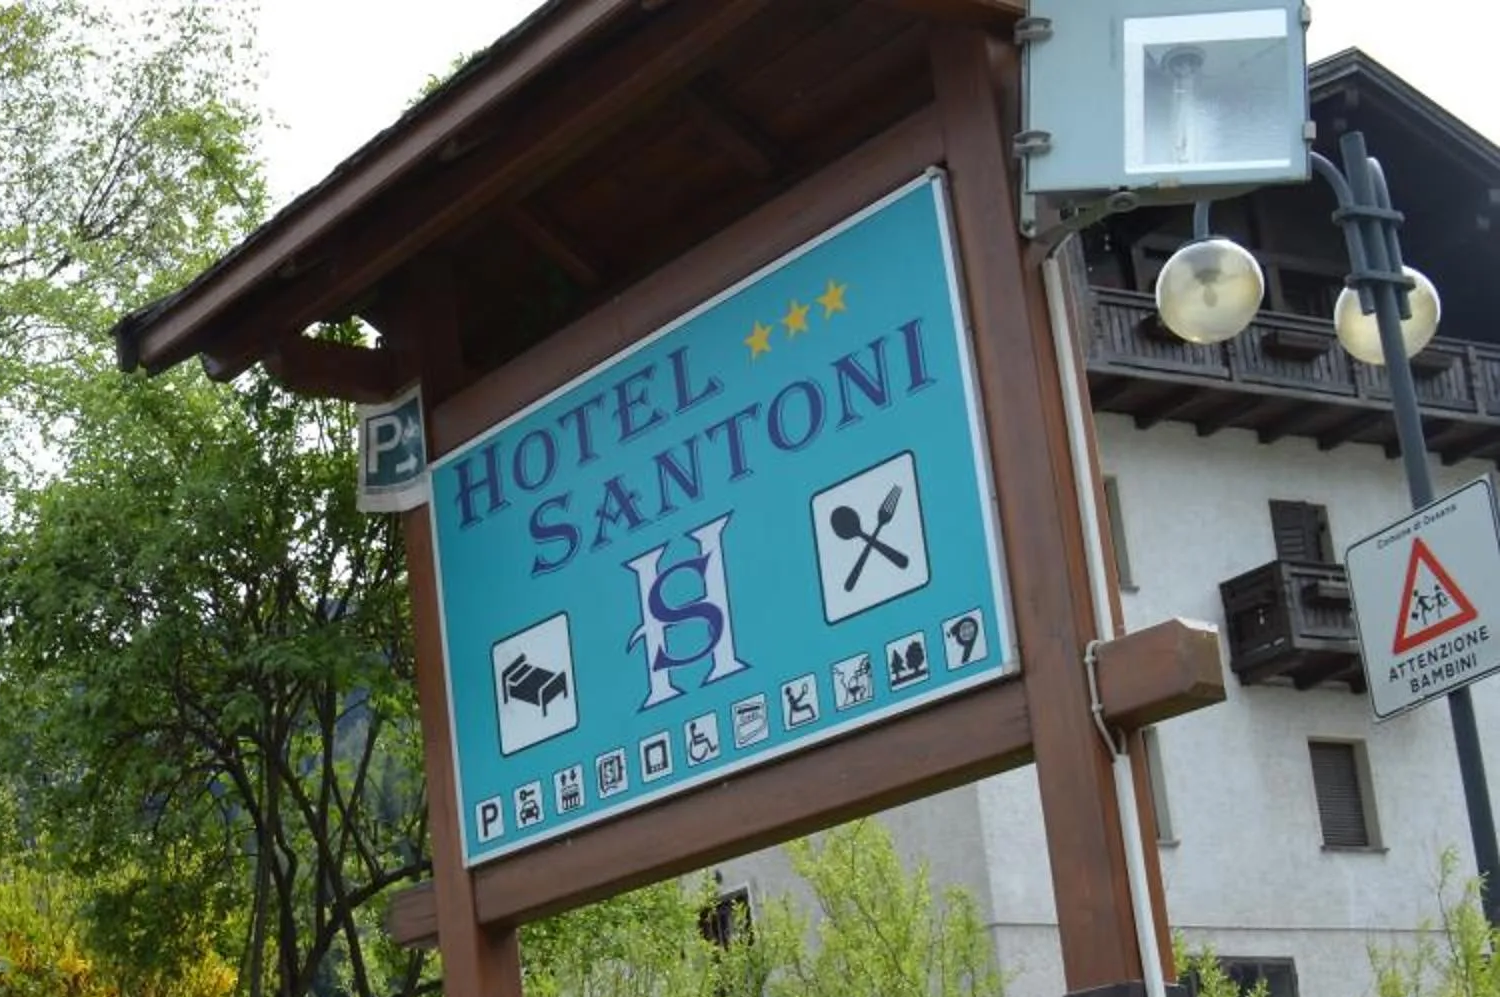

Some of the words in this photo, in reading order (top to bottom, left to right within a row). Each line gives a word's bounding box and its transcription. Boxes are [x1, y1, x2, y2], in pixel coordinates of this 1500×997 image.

[368, 414, 402, 474] P
[454, 346, 725, 531] HOTEL
[530, 318, 937, 578] SANTONI
[1389, 625, 1490, 683] ATTENZIONE
[1411, 652, 1478, 694] BAMBINI
[481, 803, 499, 838] P
